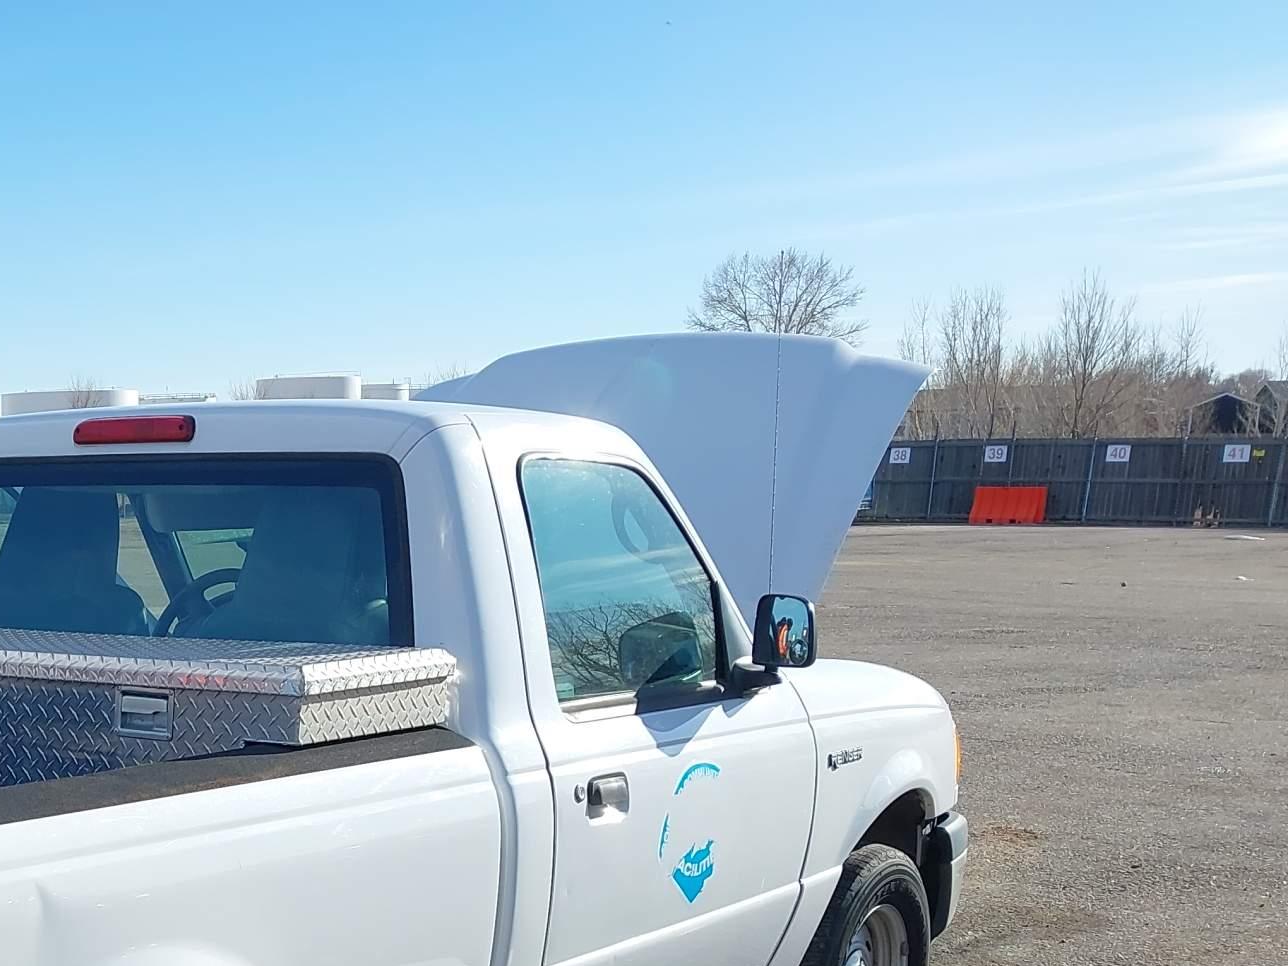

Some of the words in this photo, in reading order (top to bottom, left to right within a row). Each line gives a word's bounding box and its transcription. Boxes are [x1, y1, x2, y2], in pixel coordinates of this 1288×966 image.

[893, 449, 907, 461] 38
[988, 448, 1004, 460] 39
[1110, 447, 1127, 460] 40
[1228, 447, 1245, 459] 41
